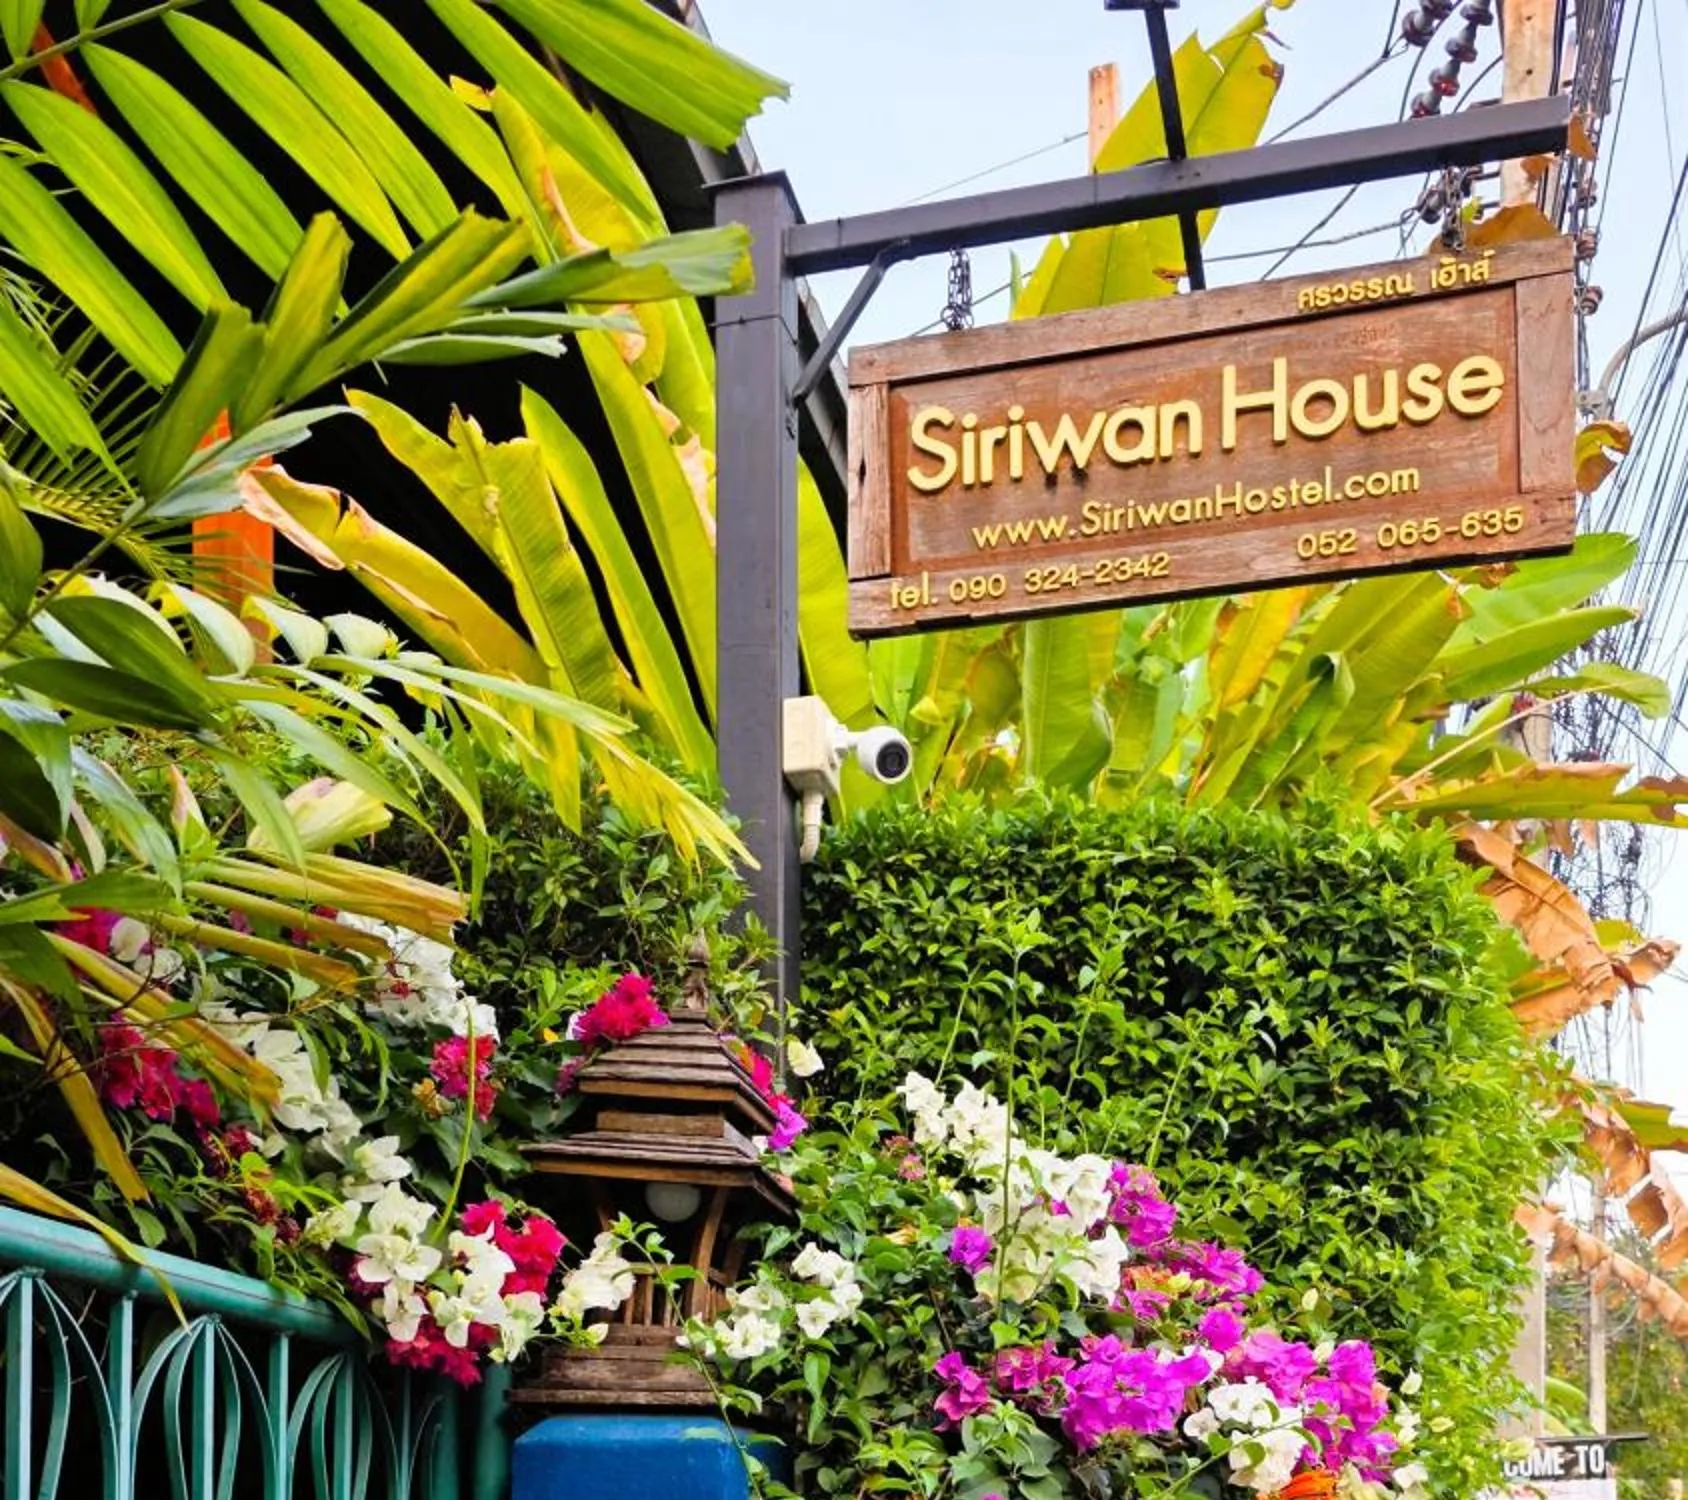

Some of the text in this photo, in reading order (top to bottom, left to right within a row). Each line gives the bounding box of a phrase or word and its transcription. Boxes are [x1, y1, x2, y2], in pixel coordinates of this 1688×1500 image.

[907, 355, 1506, 492] Siriwan House
[972, 465, 1420, 549] www.SiriwanHostel.com
[1297, 506, 1525, 559] 052 065-635
[889, 552, 1170, 609] tel. 090 324-2342
[1575, 1445, 1605, 1475] TO
